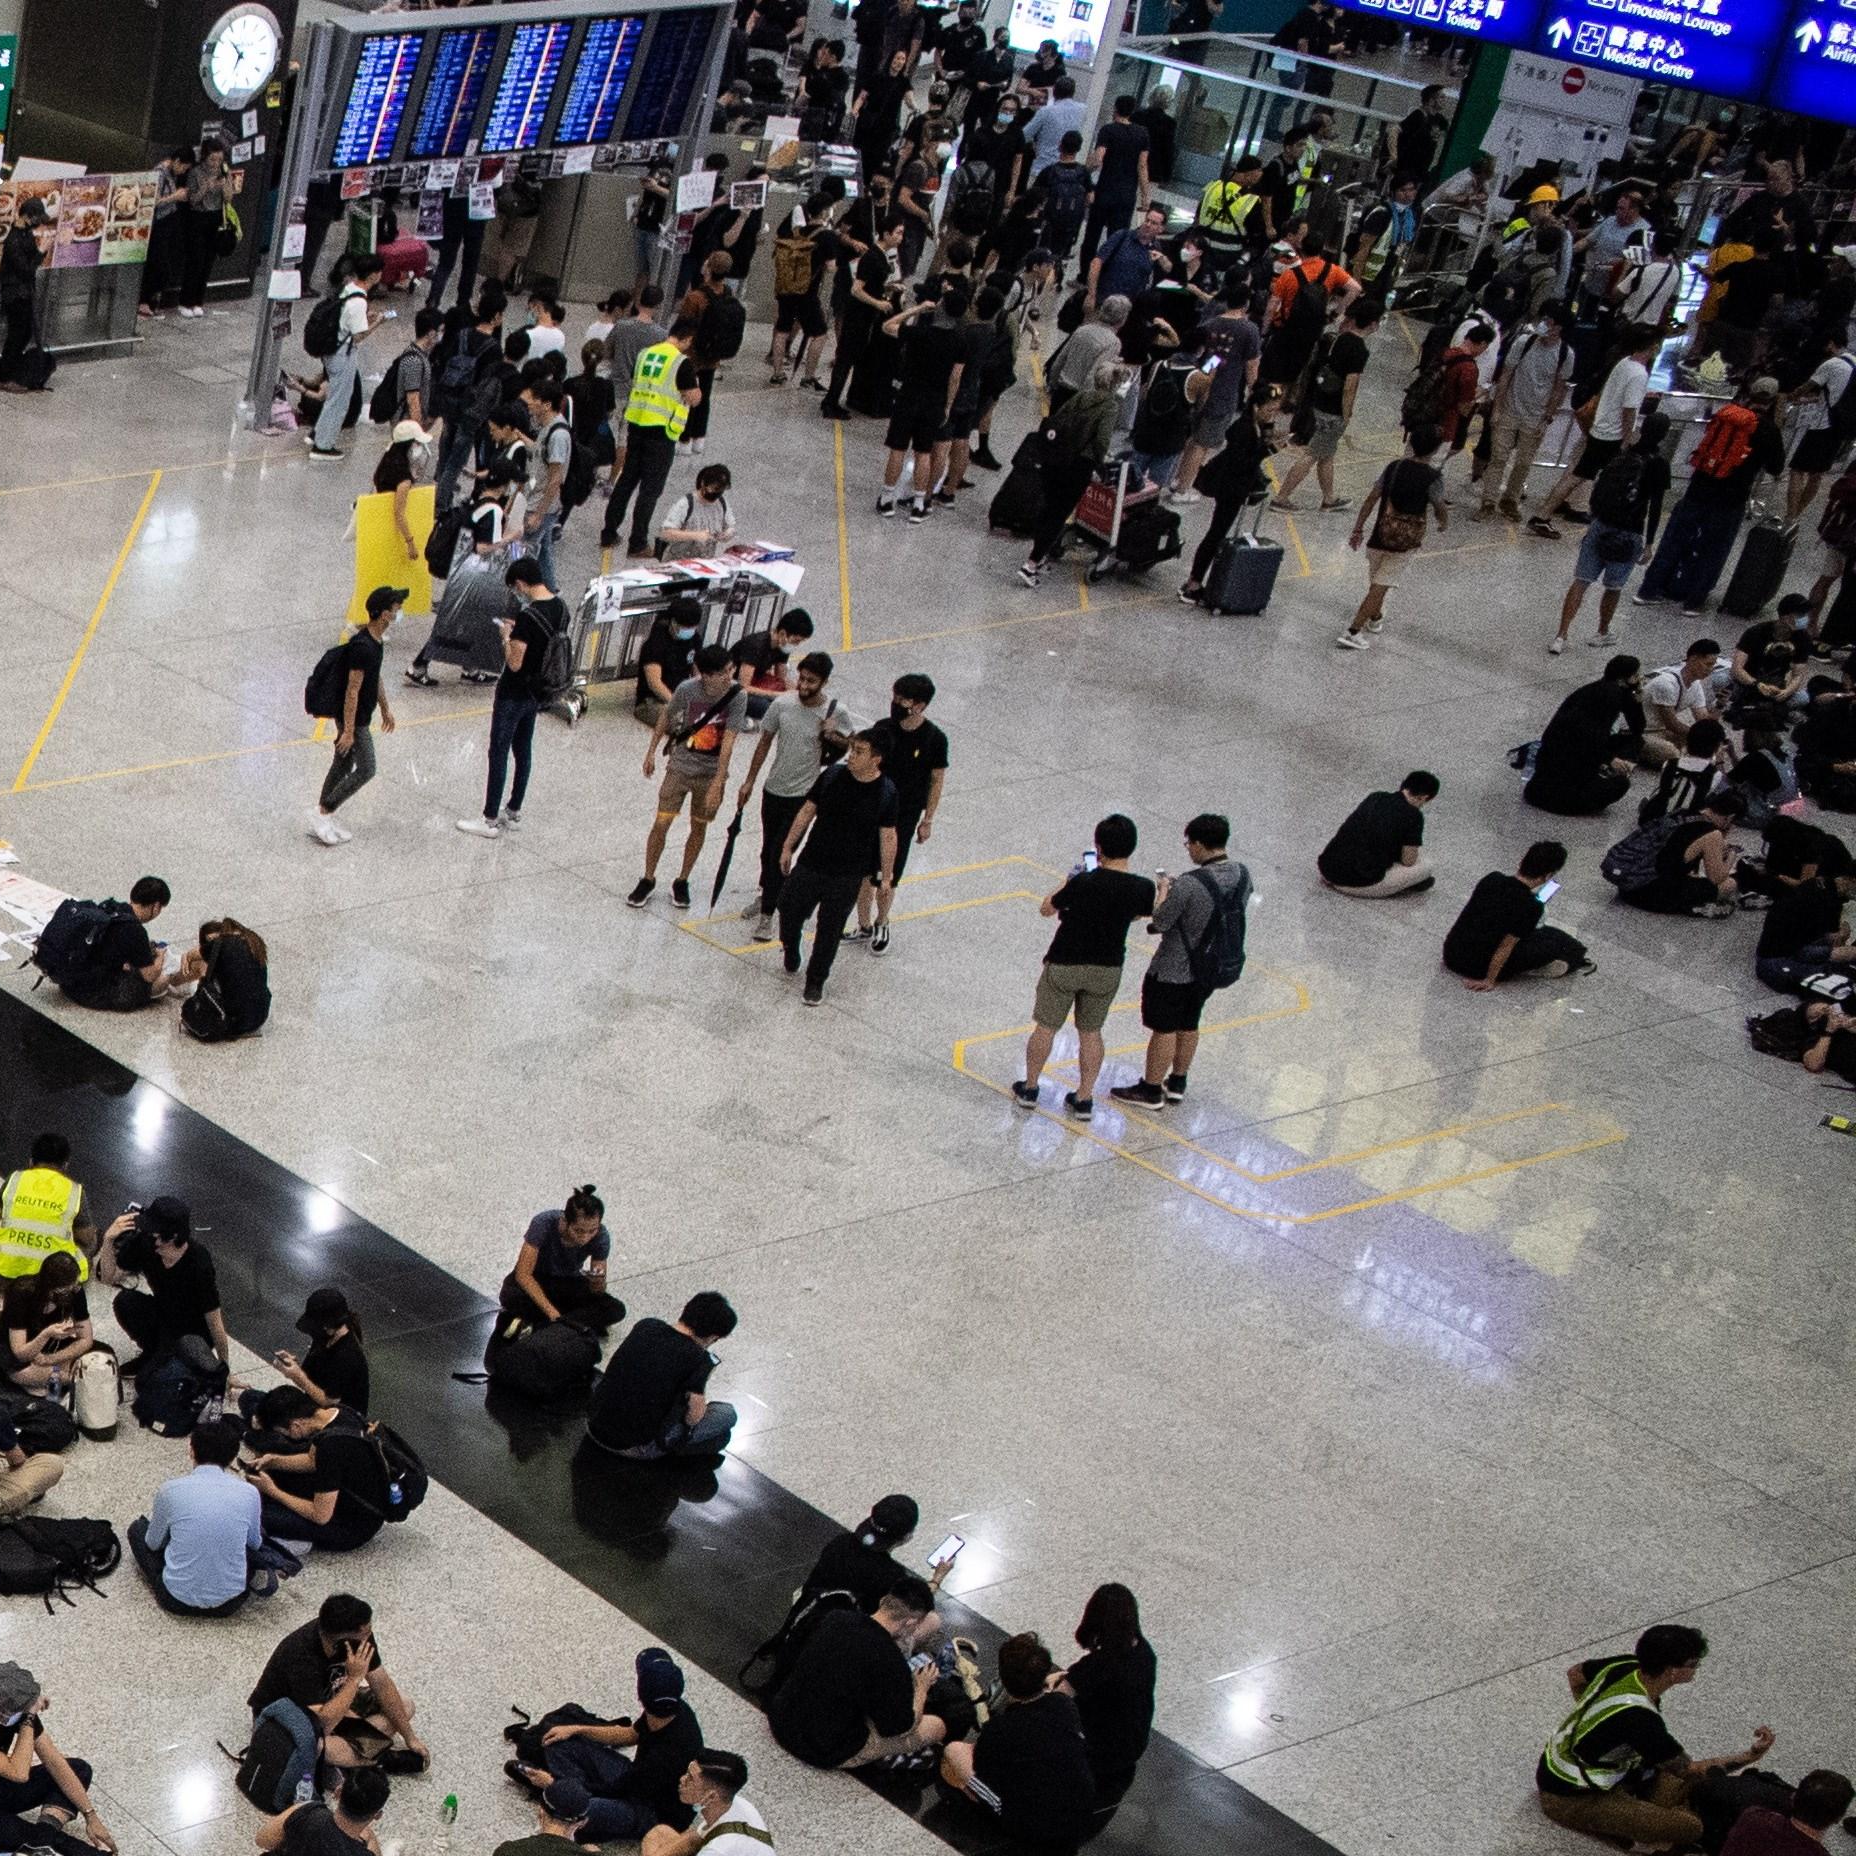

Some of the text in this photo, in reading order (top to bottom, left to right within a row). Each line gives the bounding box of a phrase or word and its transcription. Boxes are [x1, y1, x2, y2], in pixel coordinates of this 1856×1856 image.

[1445, 10, 1482, 31] Toilets
[1617, 0, 1682, 24] Limousine
[1683, 12, 1732, 36] Lounge
[1608, 25, 1685, 59] 醫療中心
[1602, 46, 1695, 80] Medical Centre
[15, 1196, 63, 1212] REUTERS
[9, 1230, 52, 1249] PRESS
